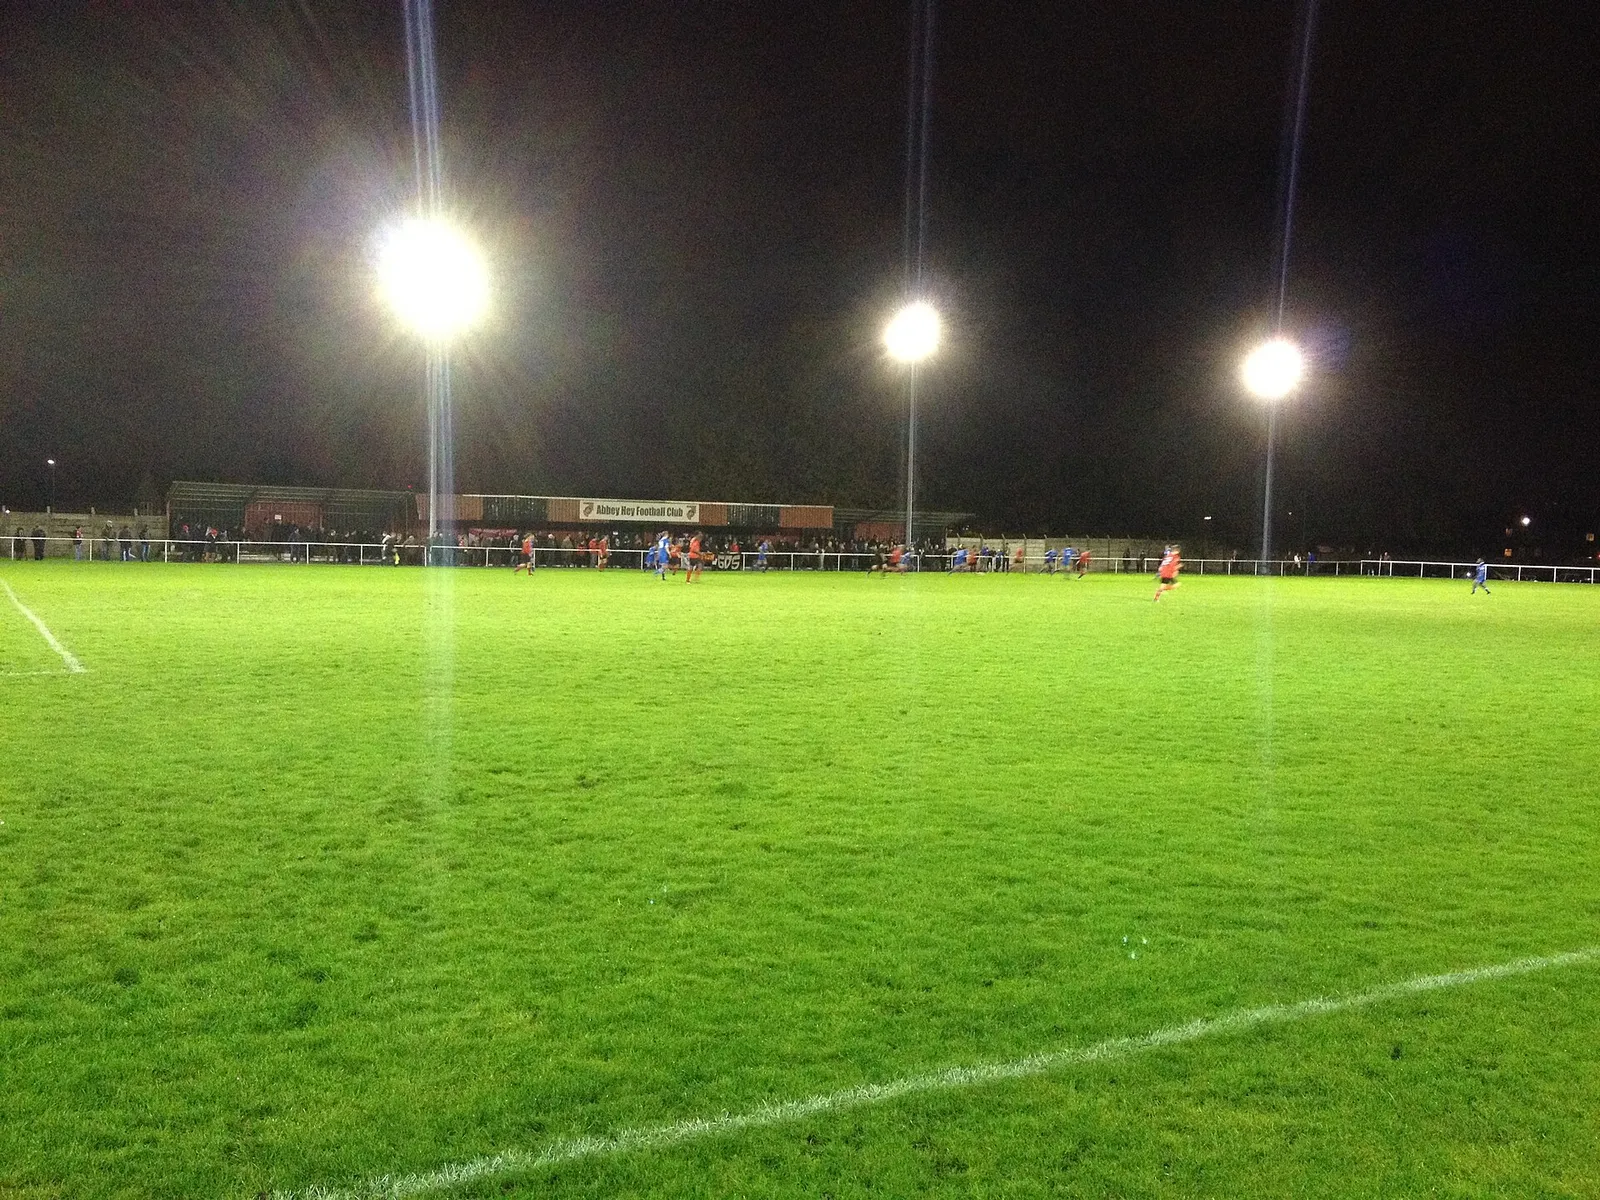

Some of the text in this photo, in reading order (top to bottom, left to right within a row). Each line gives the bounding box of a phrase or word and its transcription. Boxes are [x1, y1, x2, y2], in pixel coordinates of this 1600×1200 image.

[596, 505, 683, 517] Abbey Hey Football Club
